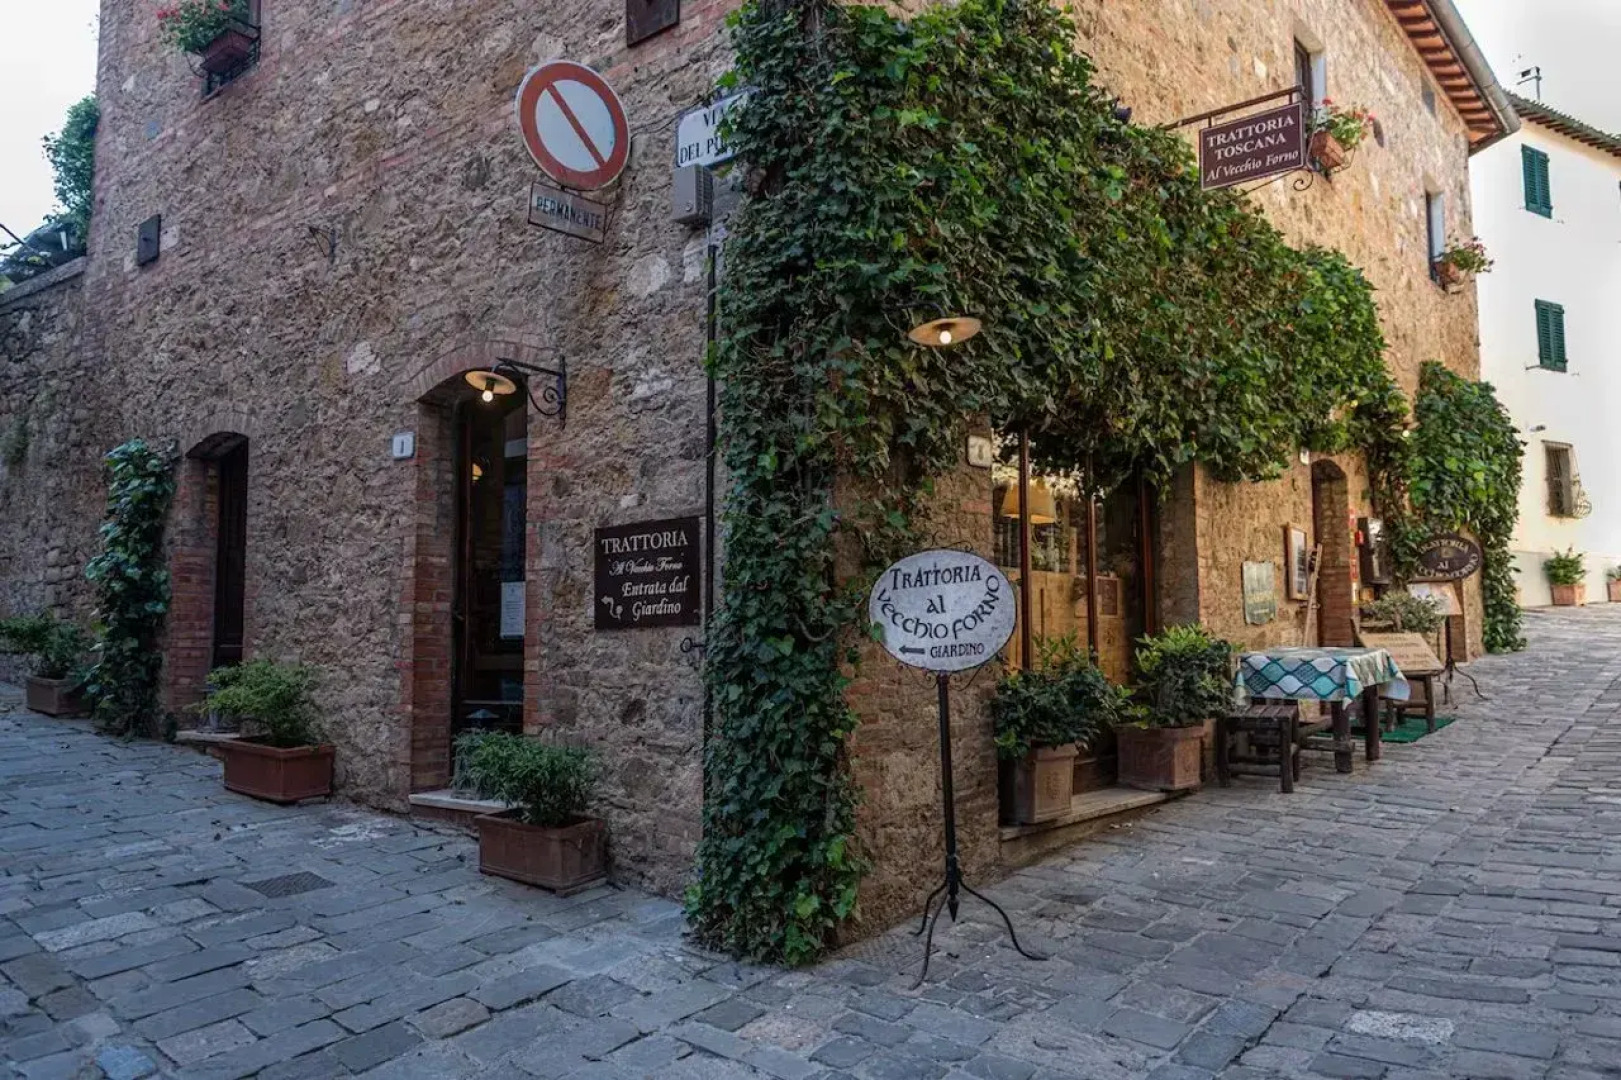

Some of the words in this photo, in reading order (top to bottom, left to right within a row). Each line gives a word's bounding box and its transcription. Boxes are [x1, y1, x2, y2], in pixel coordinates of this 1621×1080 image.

[1207, 115, 1295, 148] TRATTORIA
[680, 142, 705, 164] DEL
[1215, 133, 1287, 160] TOSCANA
[1206, 166, 1222, 182] Al
[1223, 158, 1262, 177] Vecchio
[1266, 150, 1299, 167] Forno
[536, 195, 602, 229] PERMANENTE
[601, 530, 689, 555] TRATTORIA
[622, 581, 667, 597] Entrata
[669, 575, 690, 593] dal
[890, 563, 982, 591] TRATTORIA
[632, 597, 682, 622] Giardino
[952, 574, 1000, 640] FORNO
[930, 642, 985, 659] GIARDINO
